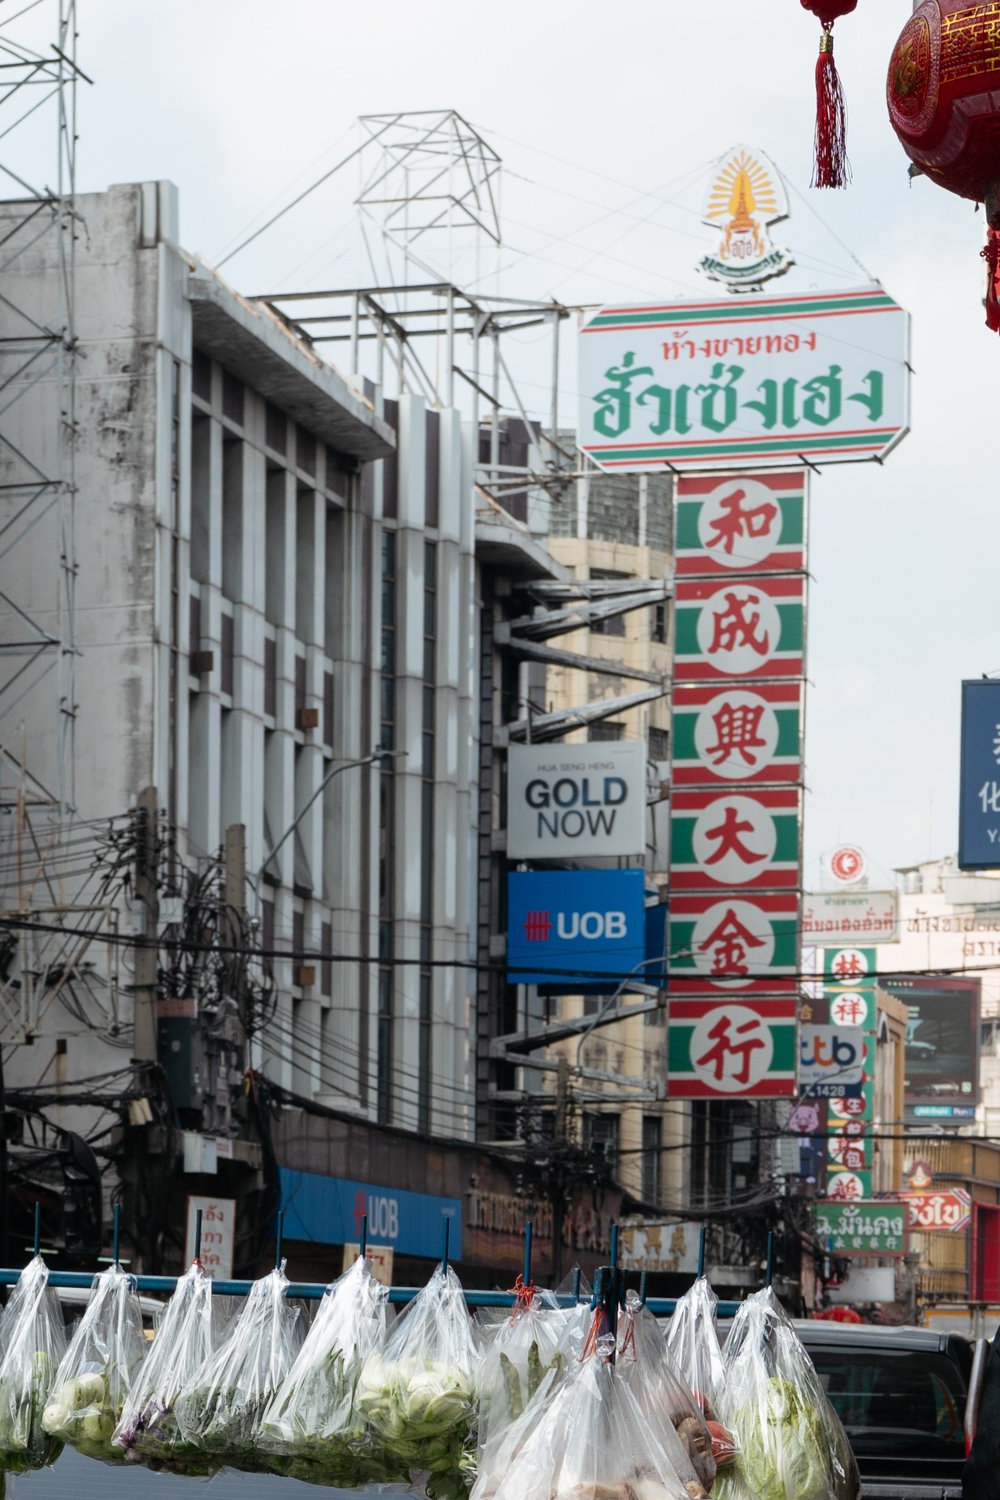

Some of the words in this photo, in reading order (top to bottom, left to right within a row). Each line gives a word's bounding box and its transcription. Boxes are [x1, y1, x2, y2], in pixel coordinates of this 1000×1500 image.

[661, 330, 817, 361] ห้างขายทอง
[592, 351, 884, 439] ฮั่วเซ่งเฮง
[537, 763, 557, 773] HUA
[560, 762, 586, 772] SENG
[588, 761, 615, 771] HENG
[525, 776, 628, 810] GOLD
[696, 488, 777, 1085] 和成興大金行
[537, 808, 617, 839] NOW
[556, 911, 628, 940] UOB
[815, 1084, 846, 1097] 1428
[368, 1195, 399, 1239] UOB
